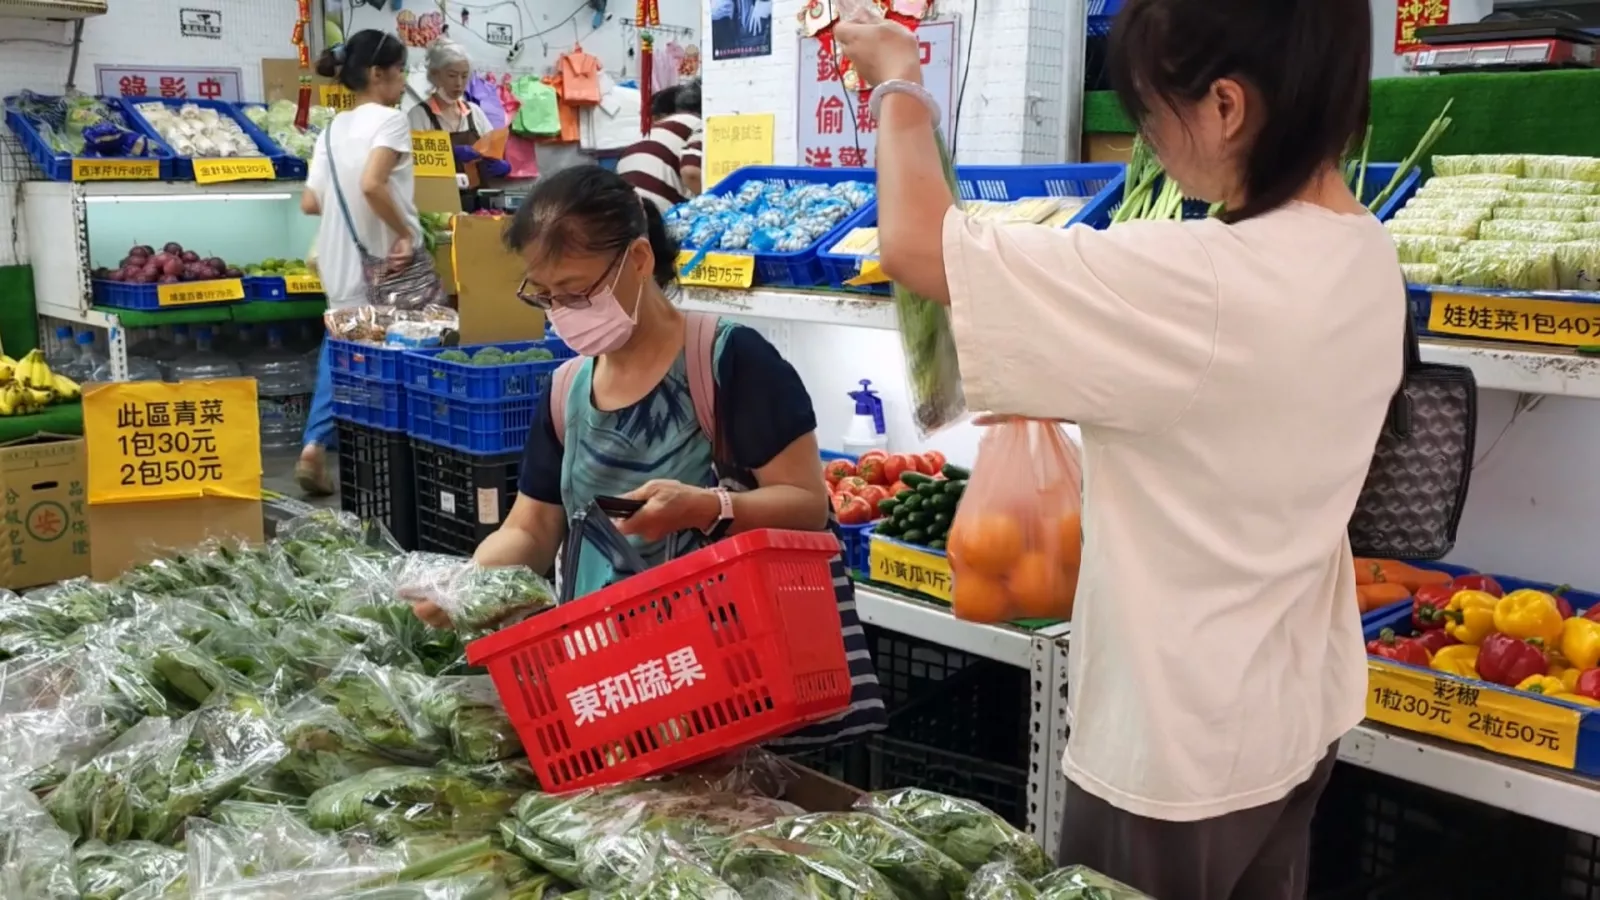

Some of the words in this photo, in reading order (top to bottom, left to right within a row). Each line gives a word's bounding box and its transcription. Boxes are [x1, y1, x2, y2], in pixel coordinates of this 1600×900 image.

[119, 75, 222, 100] 錄影中
[679, 262, 744, 285] 頭1包75元
[117, 399, 225, 429] 此區青菜
[118, 428, 217, 457] 1包30元
[120, 455, 223, 486] 2包50元
[566, 645, 706, 728] 東和蔬果
[1433, 678, 1480, 708] 彩椒
[1373, 687, 1452, 725] 1粒30元
[1467, 712, 1560, 751] 2粒50元
